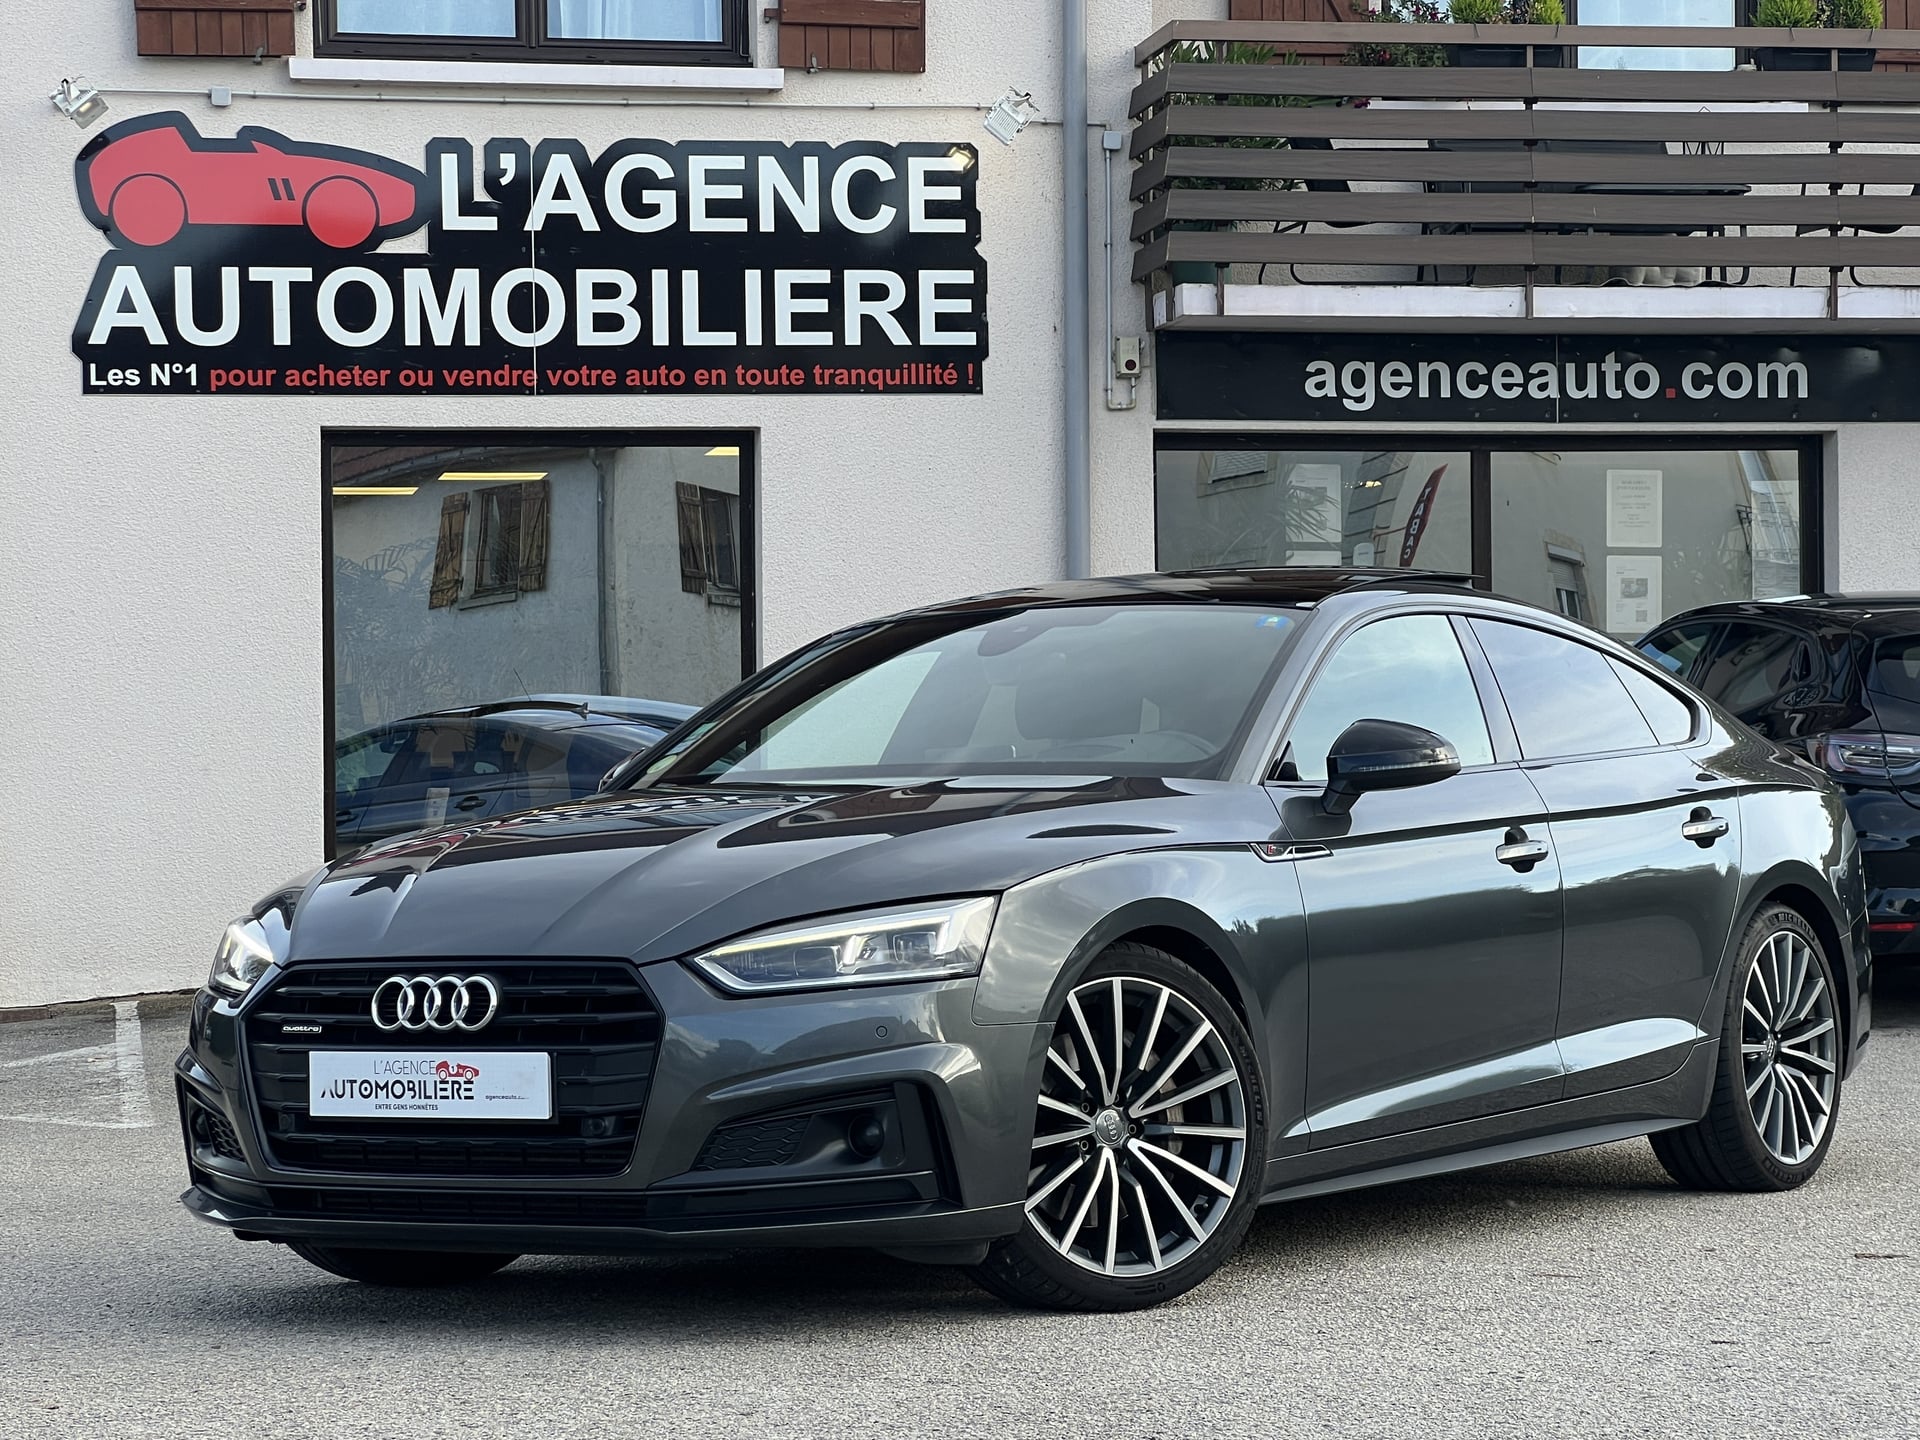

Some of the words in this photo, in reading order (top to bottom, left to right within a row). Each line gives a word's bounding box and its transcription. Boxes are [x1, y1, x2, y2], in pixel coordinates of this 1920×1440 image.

[87, 266, 977, 348] AUTOMOBILIERE
[89, 363, 141, 386] Les
[151, 363, 197, 386] N°1
[210, 369, 276, 391] pour
[285, 364, 390, 387] acheter
[399, 369, 433, 387] ou
[443, 364, 537, 387] vendre
[547, 365, 617, 387] votre
[626, 365, 686, 387] auto
[694, 369, 727, 386] en
[736, 364, 805, 386] toute
[813, 362, 958, 391] tranquillité
[967, 364, 975, 385] !
[1305, 352, 1809, 411] agenceauto.com
[374, 1060, 436, 1076] L'AGENCE
